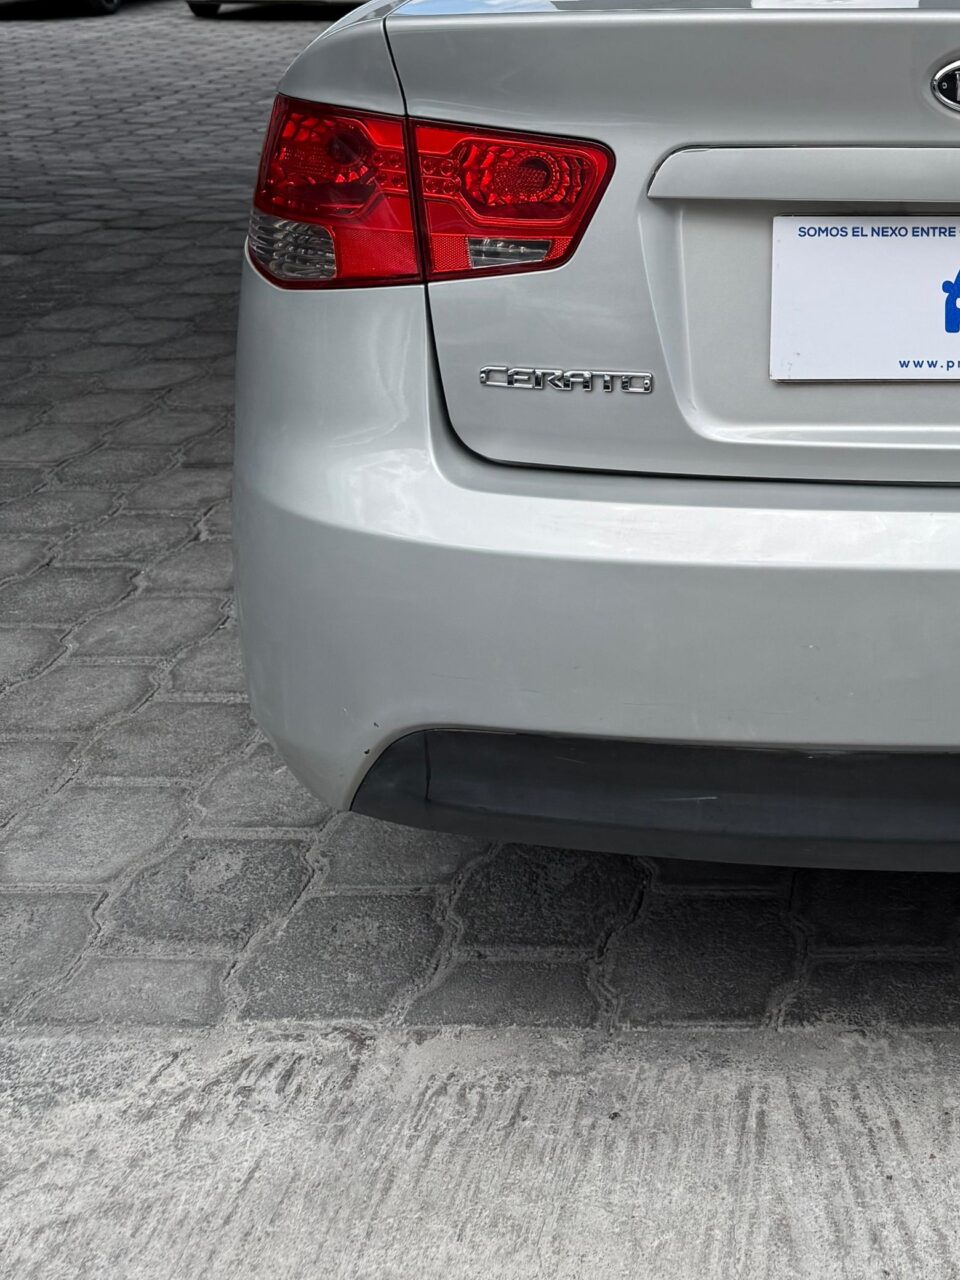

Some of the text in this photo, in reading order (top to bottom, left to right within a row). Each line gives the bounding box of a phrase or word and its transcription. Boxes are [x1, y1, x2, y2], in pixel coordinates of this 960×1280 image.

[798, 226, 848, 238] SOMOS
[851, 226, 868, 238] EL
[871, 226, 908, 238] NEXO
[912, 226, 956, 238] ENTRE
[480, 365, 654, 394] CERATO
